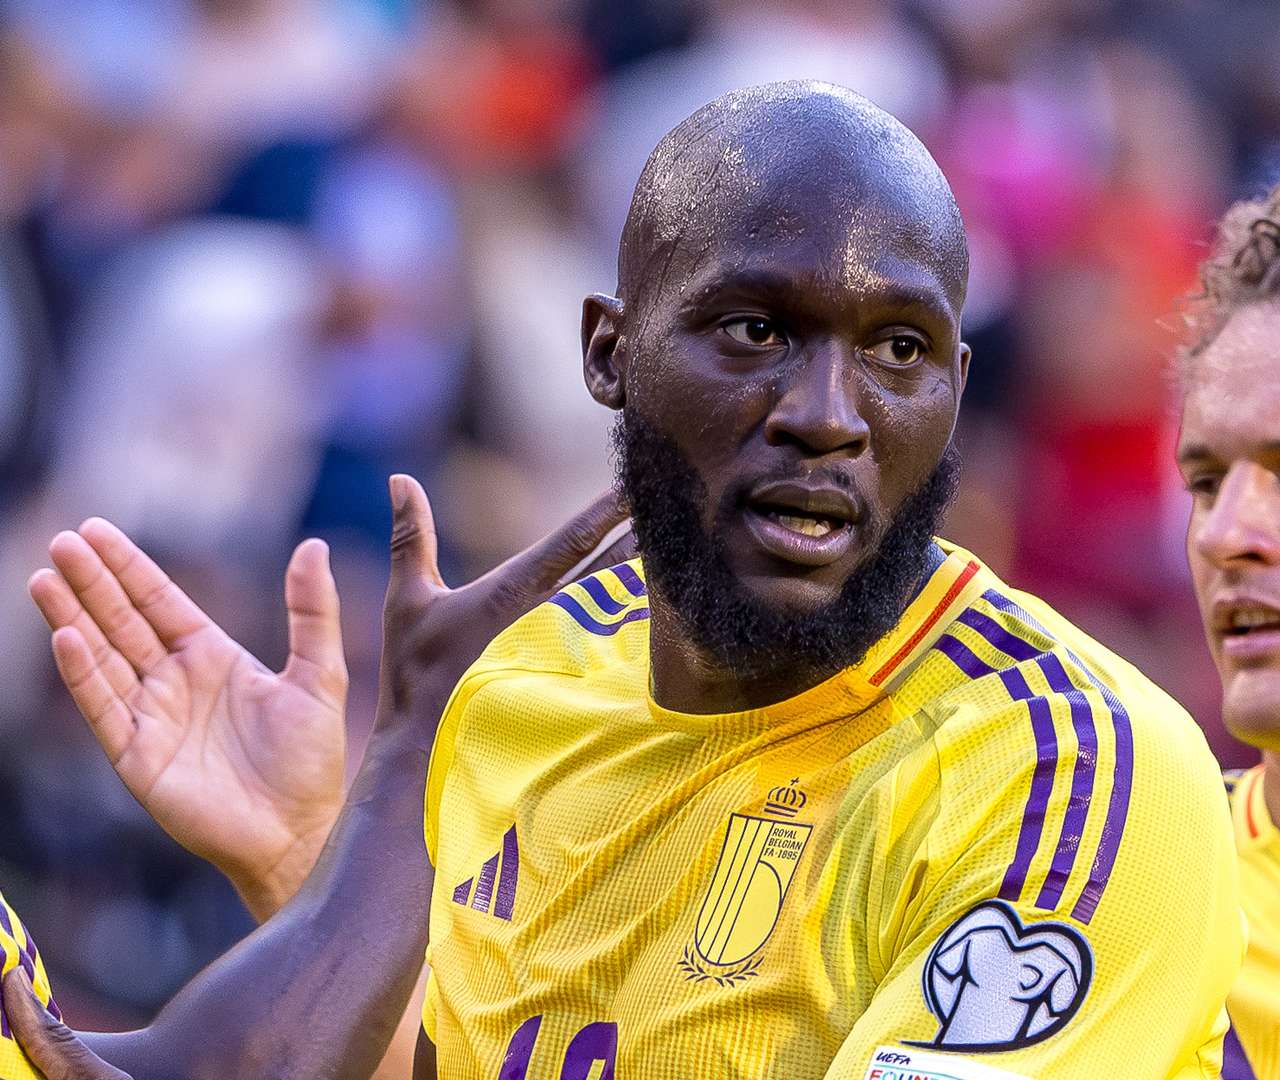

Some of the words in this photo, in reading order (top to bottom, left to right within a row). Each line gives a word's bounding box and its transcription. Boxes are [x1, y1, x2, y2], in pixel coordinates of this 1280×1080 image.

[772, 828, 797, 839] ROYAL
[768, 838, 802, 851] BELGIAN
[876, 1051, 911, 1065] UEFA
